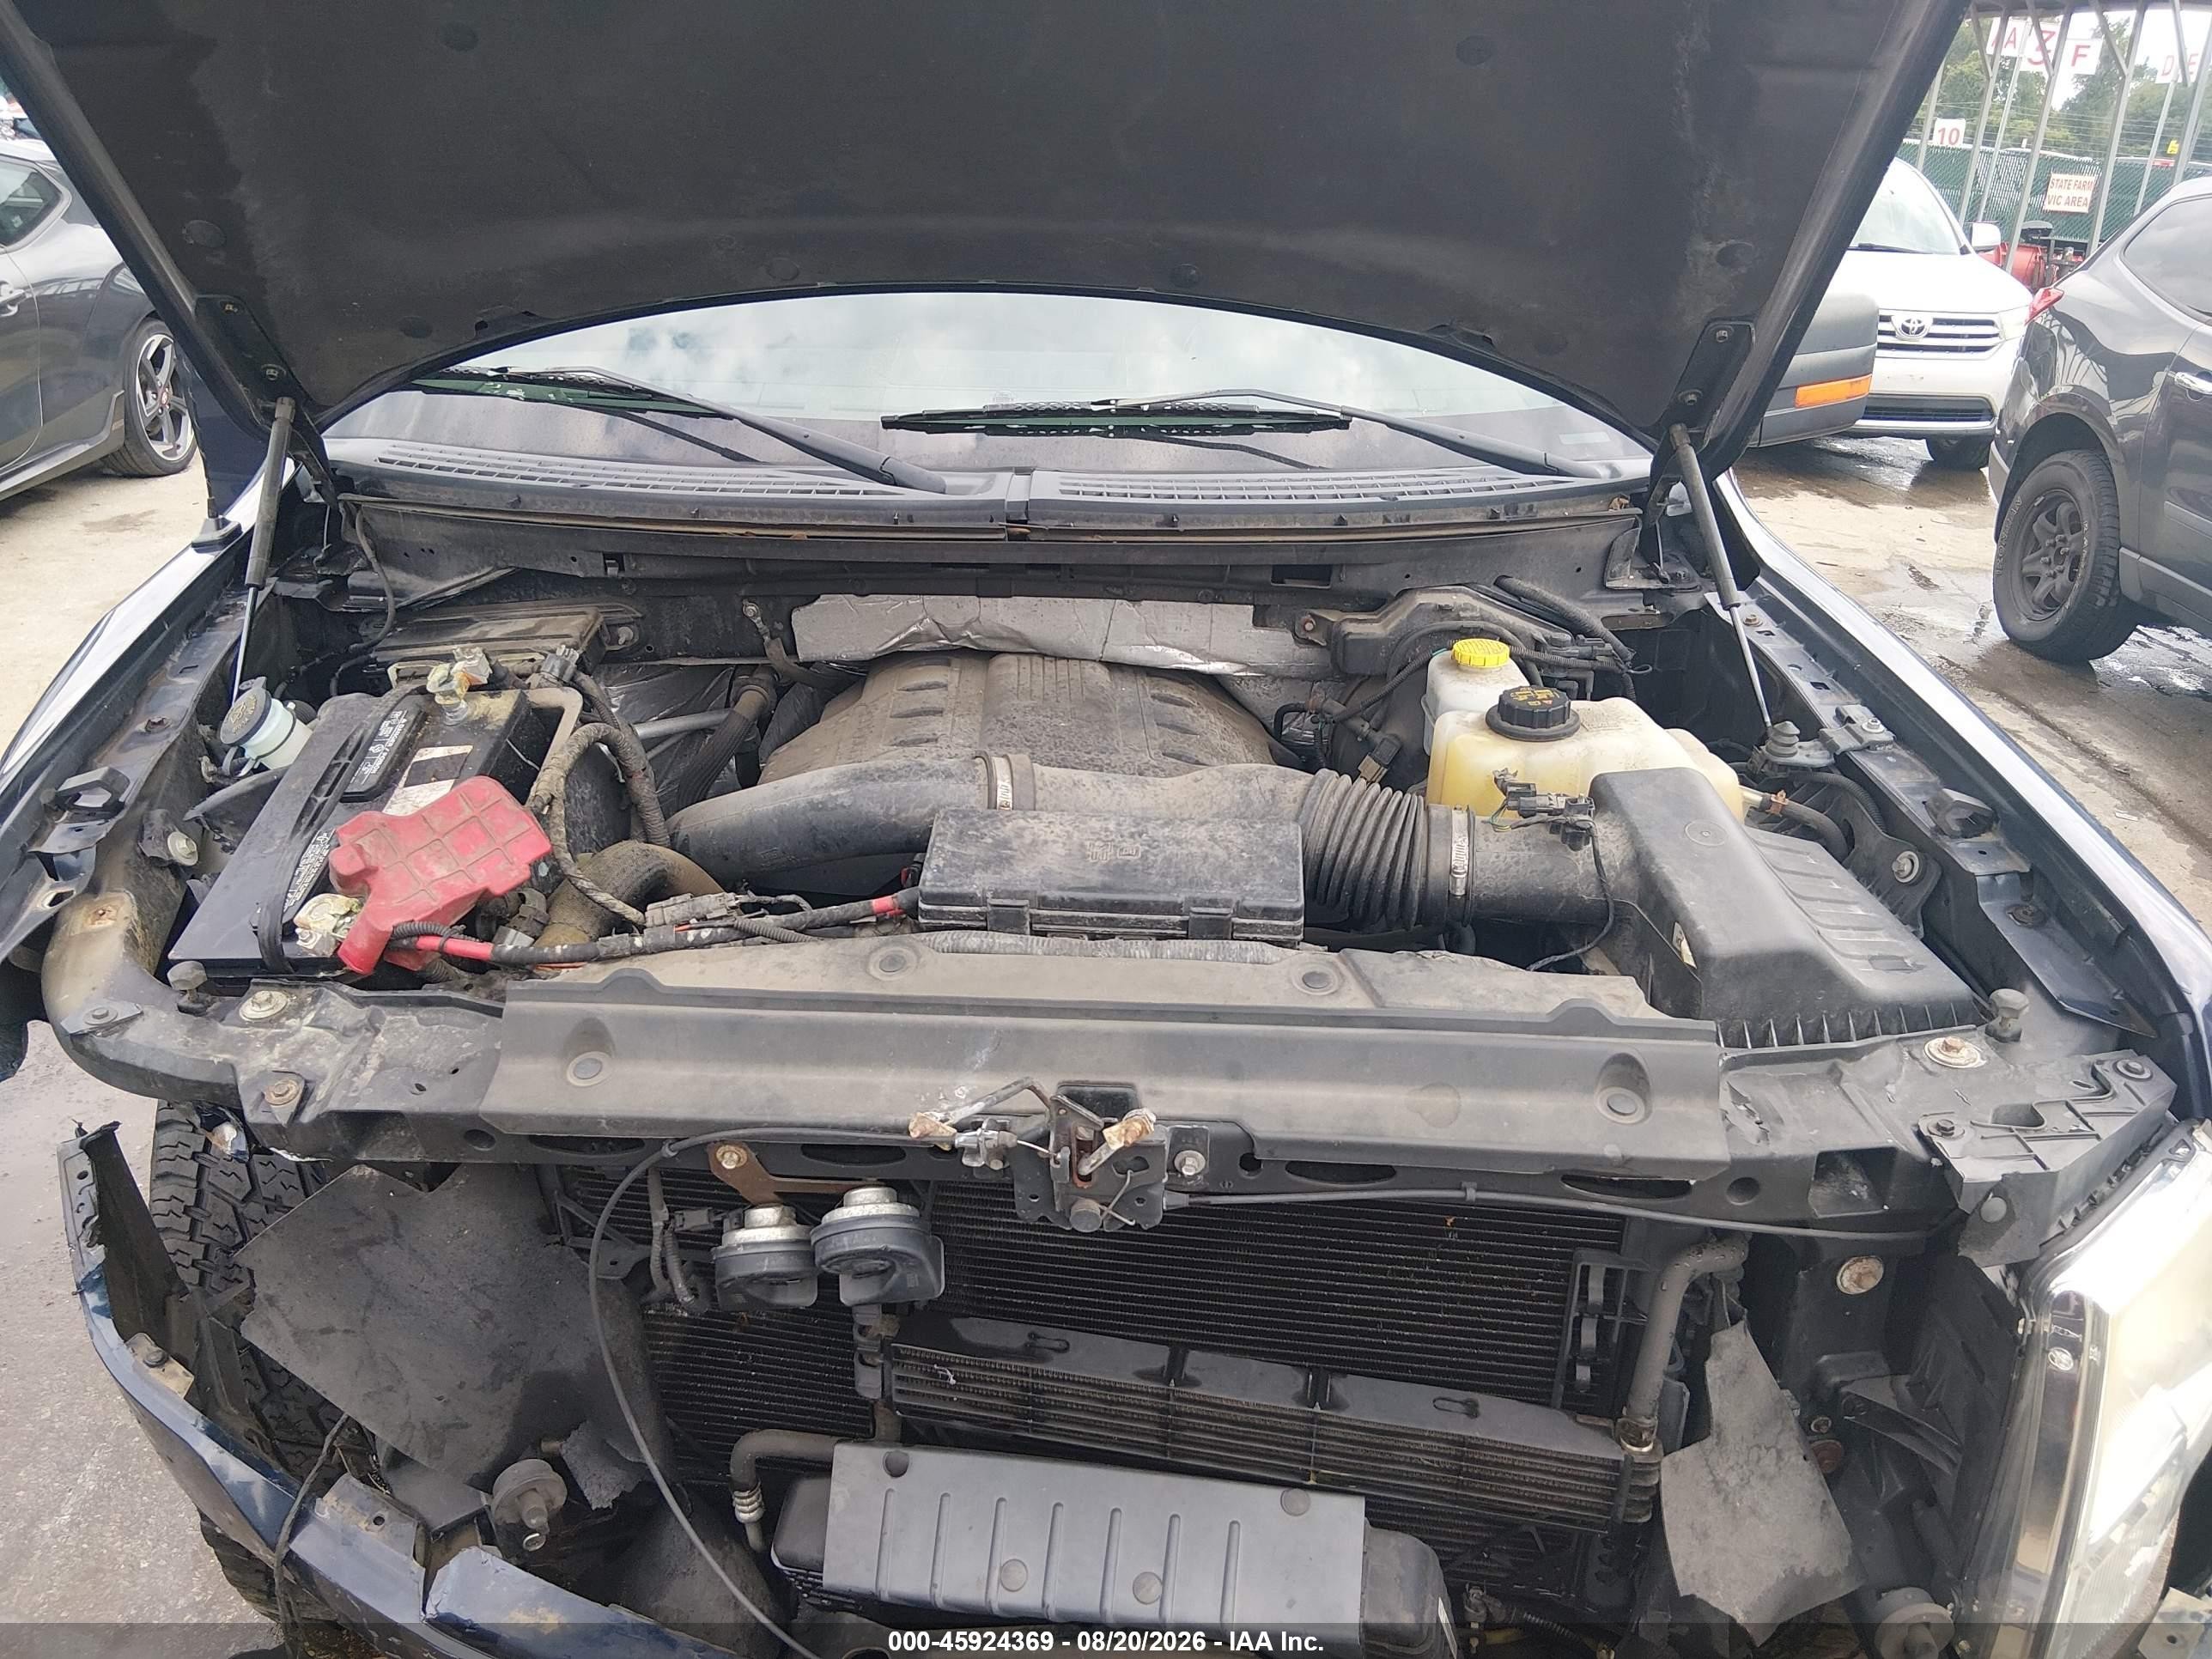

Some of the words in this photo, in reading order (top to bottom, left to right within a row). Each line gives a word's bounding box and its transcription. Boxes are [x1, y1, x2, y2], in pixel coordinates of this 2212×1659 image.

[2071, 45, 2090, 67] F
[1938, 127, 1960, 145] 10
[2050, 178, 2073, 191] STATE
[2074, 179, 2095, 191] FARM
[2047, 194, 2063, 206] VIC
[2064, 196, 2088, 207] AREA
